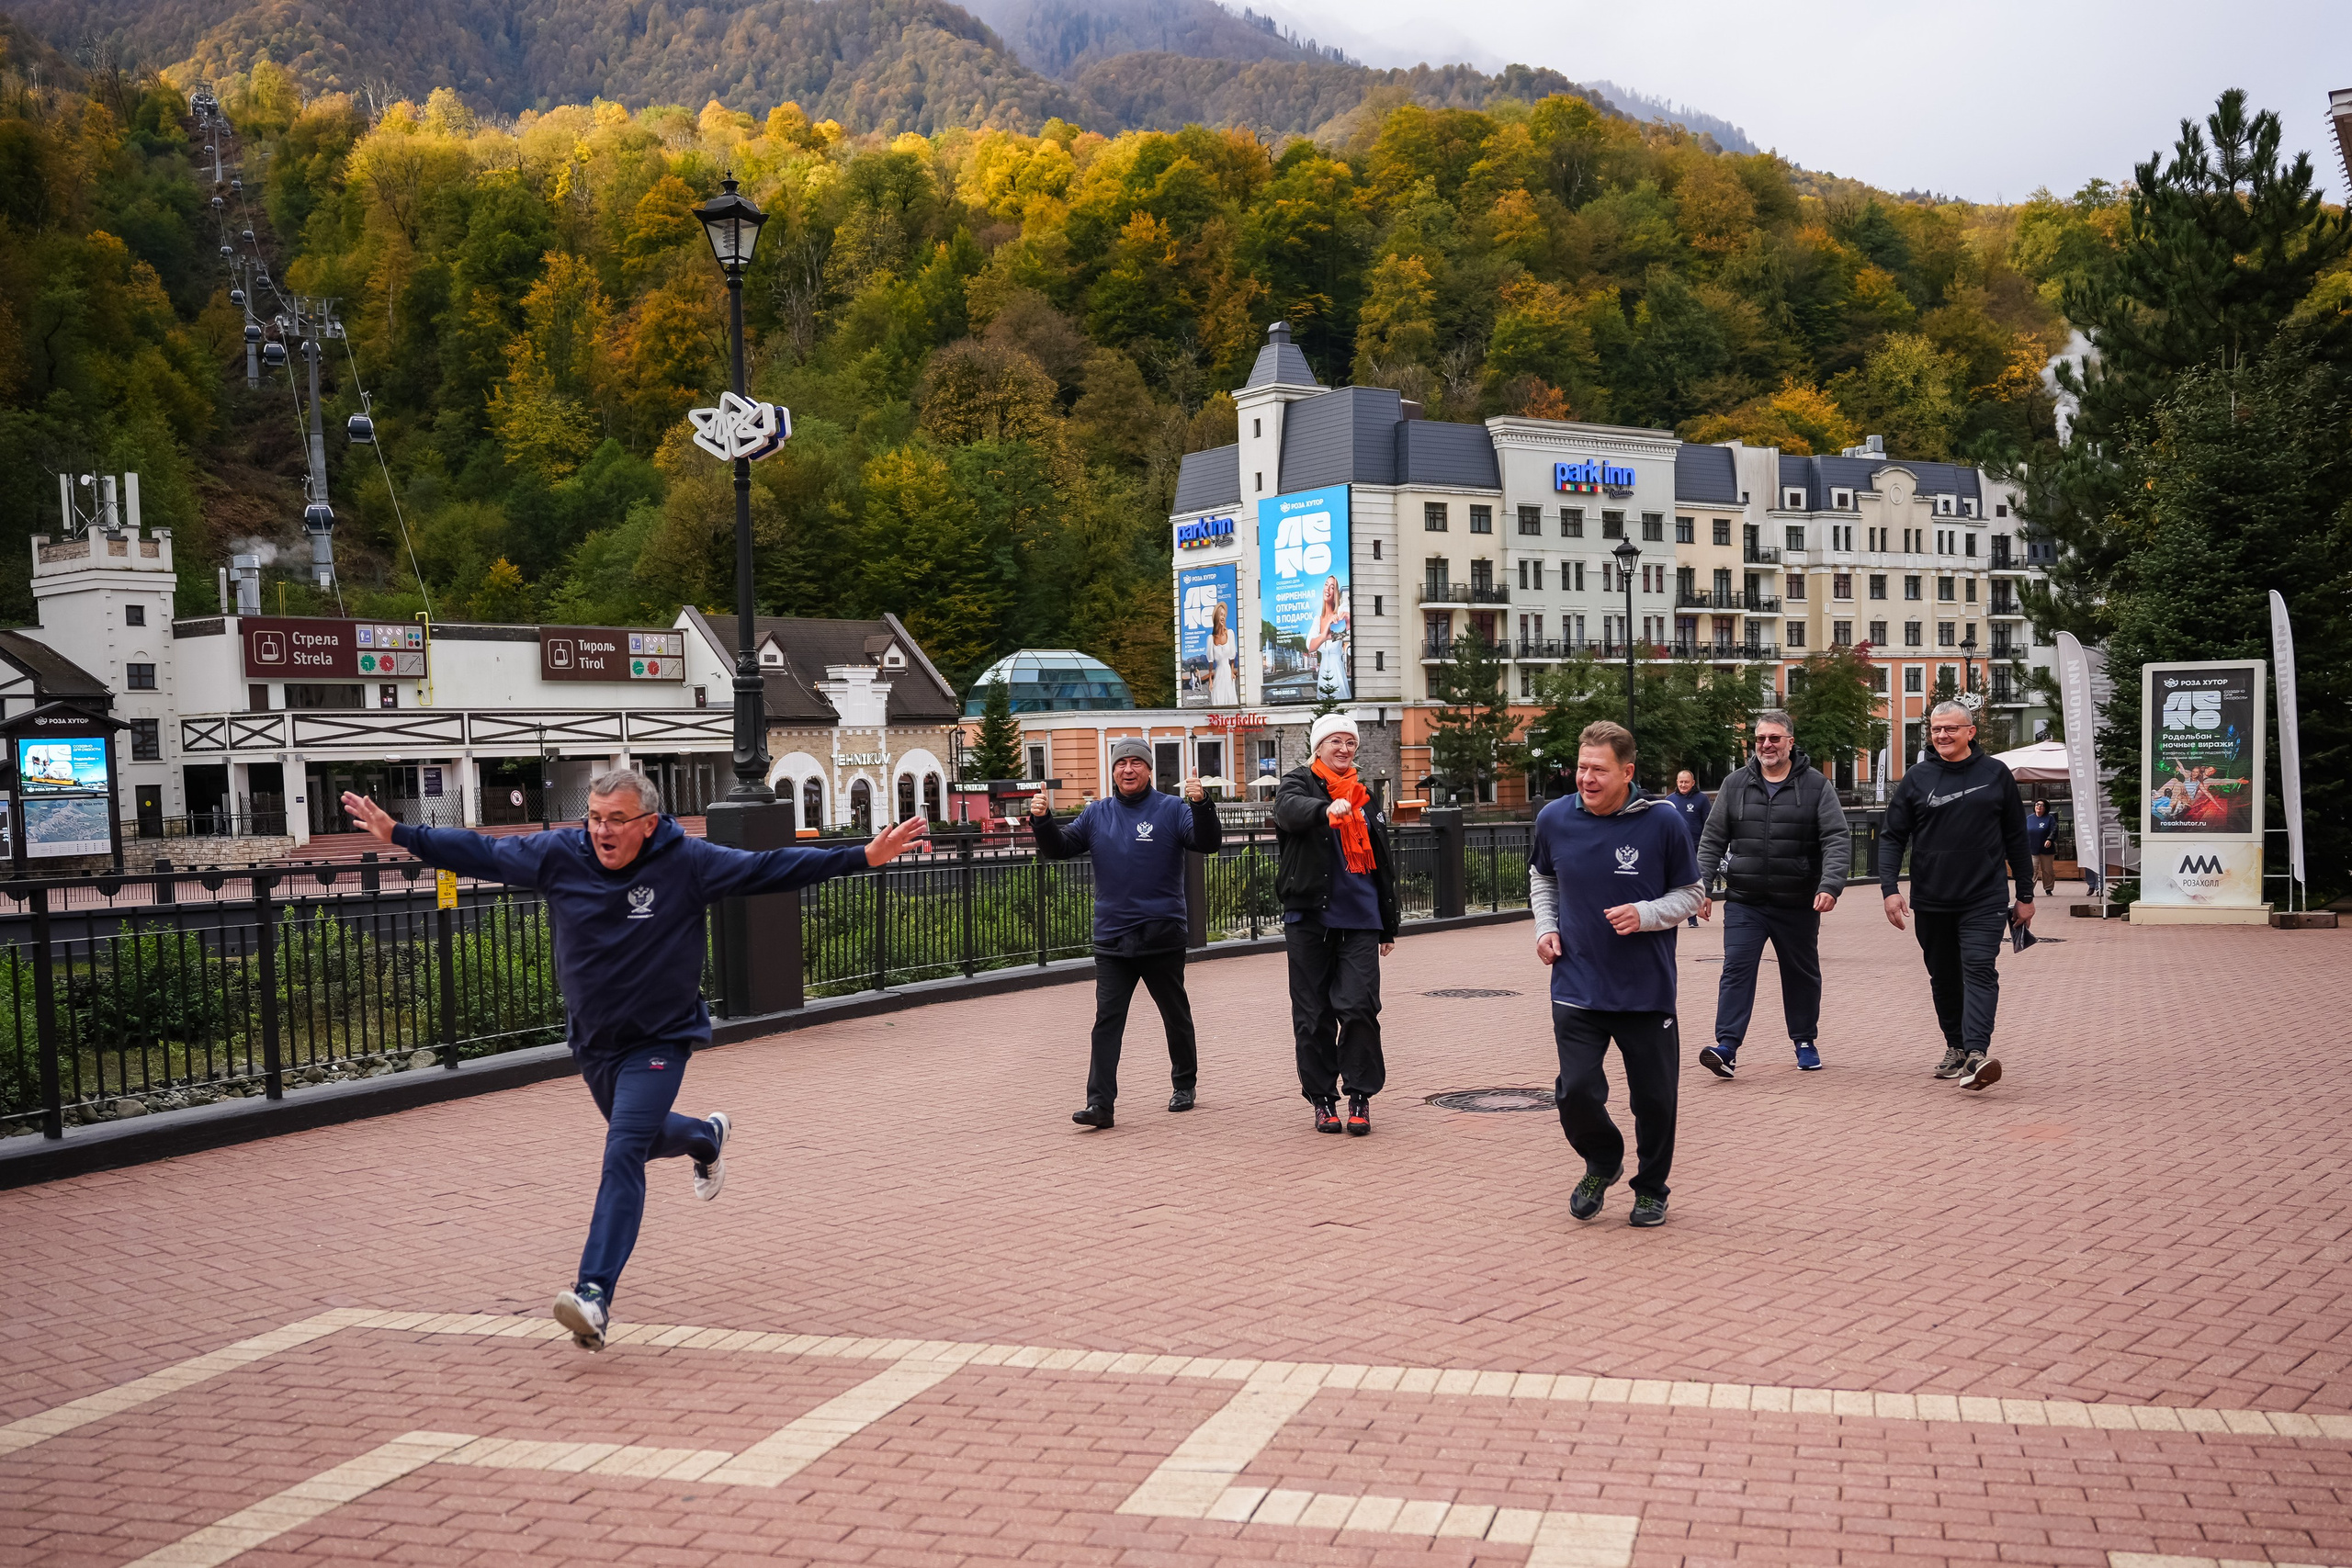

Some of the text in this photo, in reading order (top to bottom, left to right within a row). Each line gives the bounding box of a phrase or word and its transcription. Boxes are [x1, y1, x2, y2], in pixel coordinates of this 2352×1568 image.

[1555, 458, 1635, 491] park inn
[1291, 498, 1324, 510] РОЗА ХУТОР
[1177, 515, 1234, 548] park inn
[1275, 589, 1316, 602] ФИРМЕННАЯ
[1275, 601, 1310, 614] ОТКРЫТКА
[1275, 611, 1314, 624] В ПОДАРОК
[292, 631, 339, 649] Стрела
[578, 639, 616, 654] Тироль
[293, 651, 334, 666] Strela
[579, 658, 605, 670] Tirol
[2162, 732, 2212, 741] Родельбан
[2198, 741, 2233, 750] виражи
[831, 752, 891, 766] TEHNIKUM
[955, 784, 989, 792] TEHNIKUM
